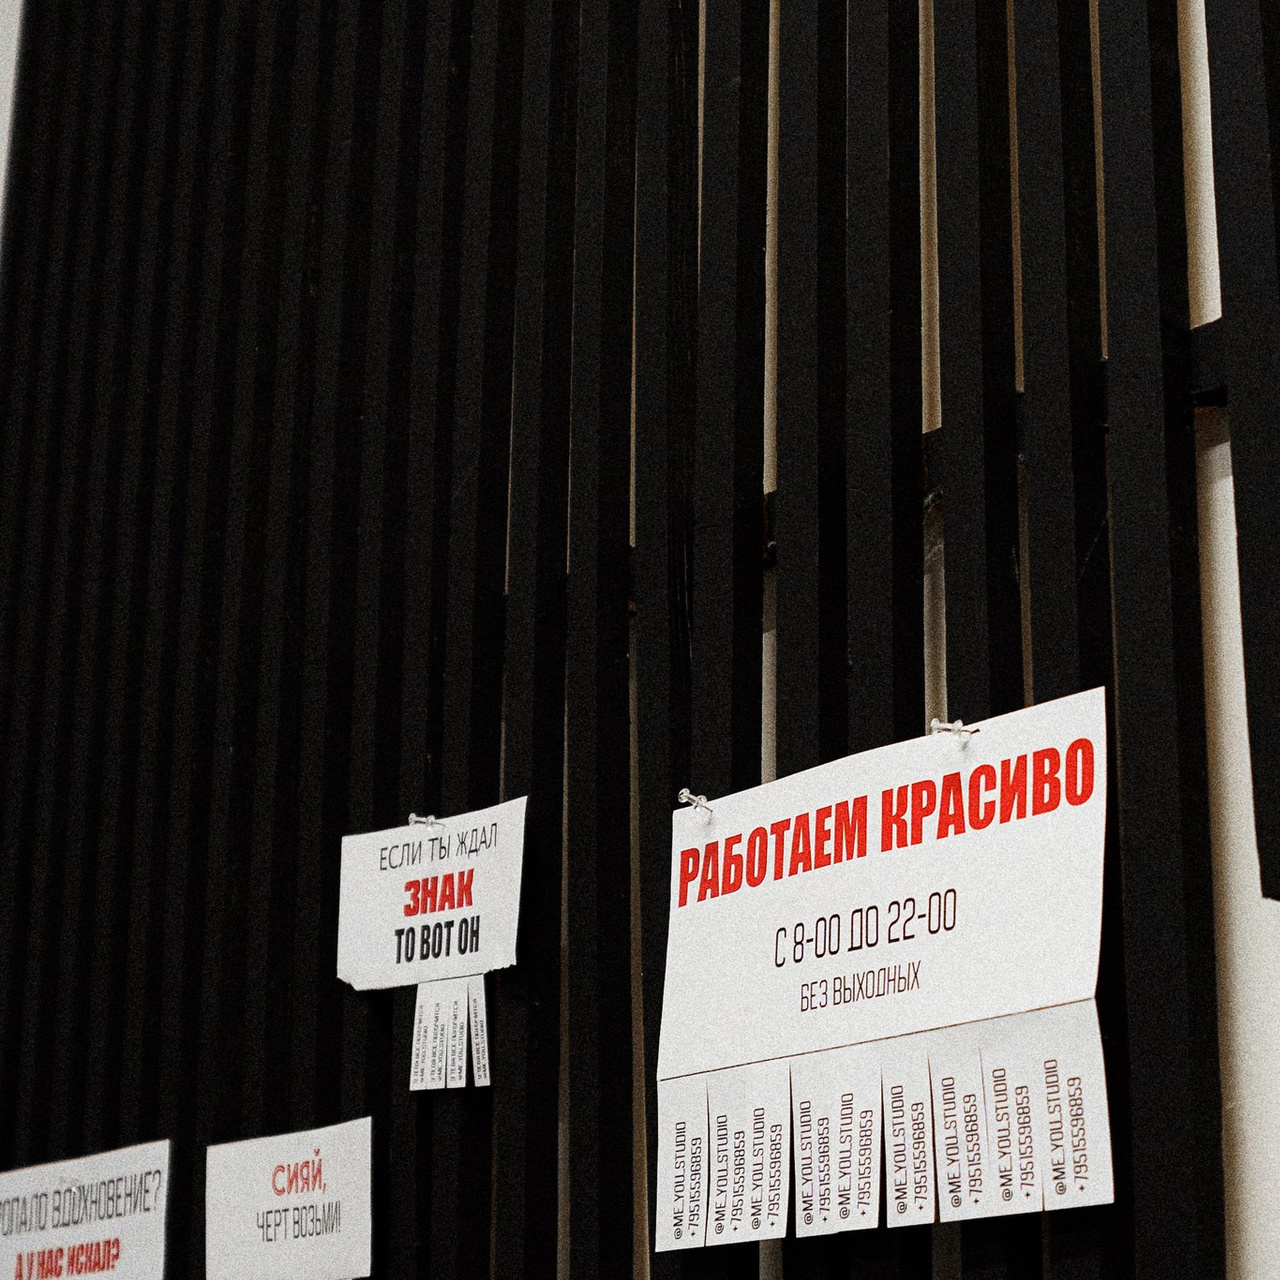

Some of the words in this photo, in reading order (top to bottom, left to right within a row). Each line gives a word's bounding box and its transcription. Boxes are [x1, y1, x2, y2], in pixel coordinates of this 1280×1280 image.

[379, 840, 423, 872] ЕСЛИ
[427, 836, 451, 861] ТЫ
[456, 822, 498, 858] ЖДАЛ
[678, 794, 868, 908] РАБОТАЕМ
[880, 737, 1095, 853] КРАСИВО
[394, 926, 416, 964] ТО
[419, 919, 455, 961] ВОТ
[457, 915, 481, 955] ОН
[403, 868, 475, 917] ЗНАК
[774, 926, 788, 969] С
[792, 913, 841, 964] 8-00
[847, 904, 879, 953] ДО
[887, 887, 958, 944] 22-00
[799, 978, 829, 1013] БЕЗ
[832, 960, 921, 1007] ВЫХОДНЫХ
[271, 1148, 327, 1197] СИЯЙ,
[730, 1129, 746, 1232] +79515596859
[766, 1123, 783, 1227] +79515596859
[817, 1116, 831, 1223] +79515596859
[857, 1109, 874, 1217] +79515596859
[910, 1101, 928, 1211] +79515596859
[962, 1093, 983, 1205] +79515596859
[1014, 1084, 1035, 1199] +79515596859
[1066, 1076, 1089, 1192] +79515596859
[0, 1192, 49, 1237] ОПАЛО
[51, 1170, 162, 1229] ВДОХНОВЕНИЕ?
[256, 1207, 290, 1243] ЧЕРТ
[292, 1201, 342, 1240] ВОЗЬМИ!
[687, 1136, 702, 1238] +79515596859
[26, 1252, 35, 1280] У
[37, 1247, 65, 1280] НАС
[67, 1238, 121, 1275] ИСКАЛ?
